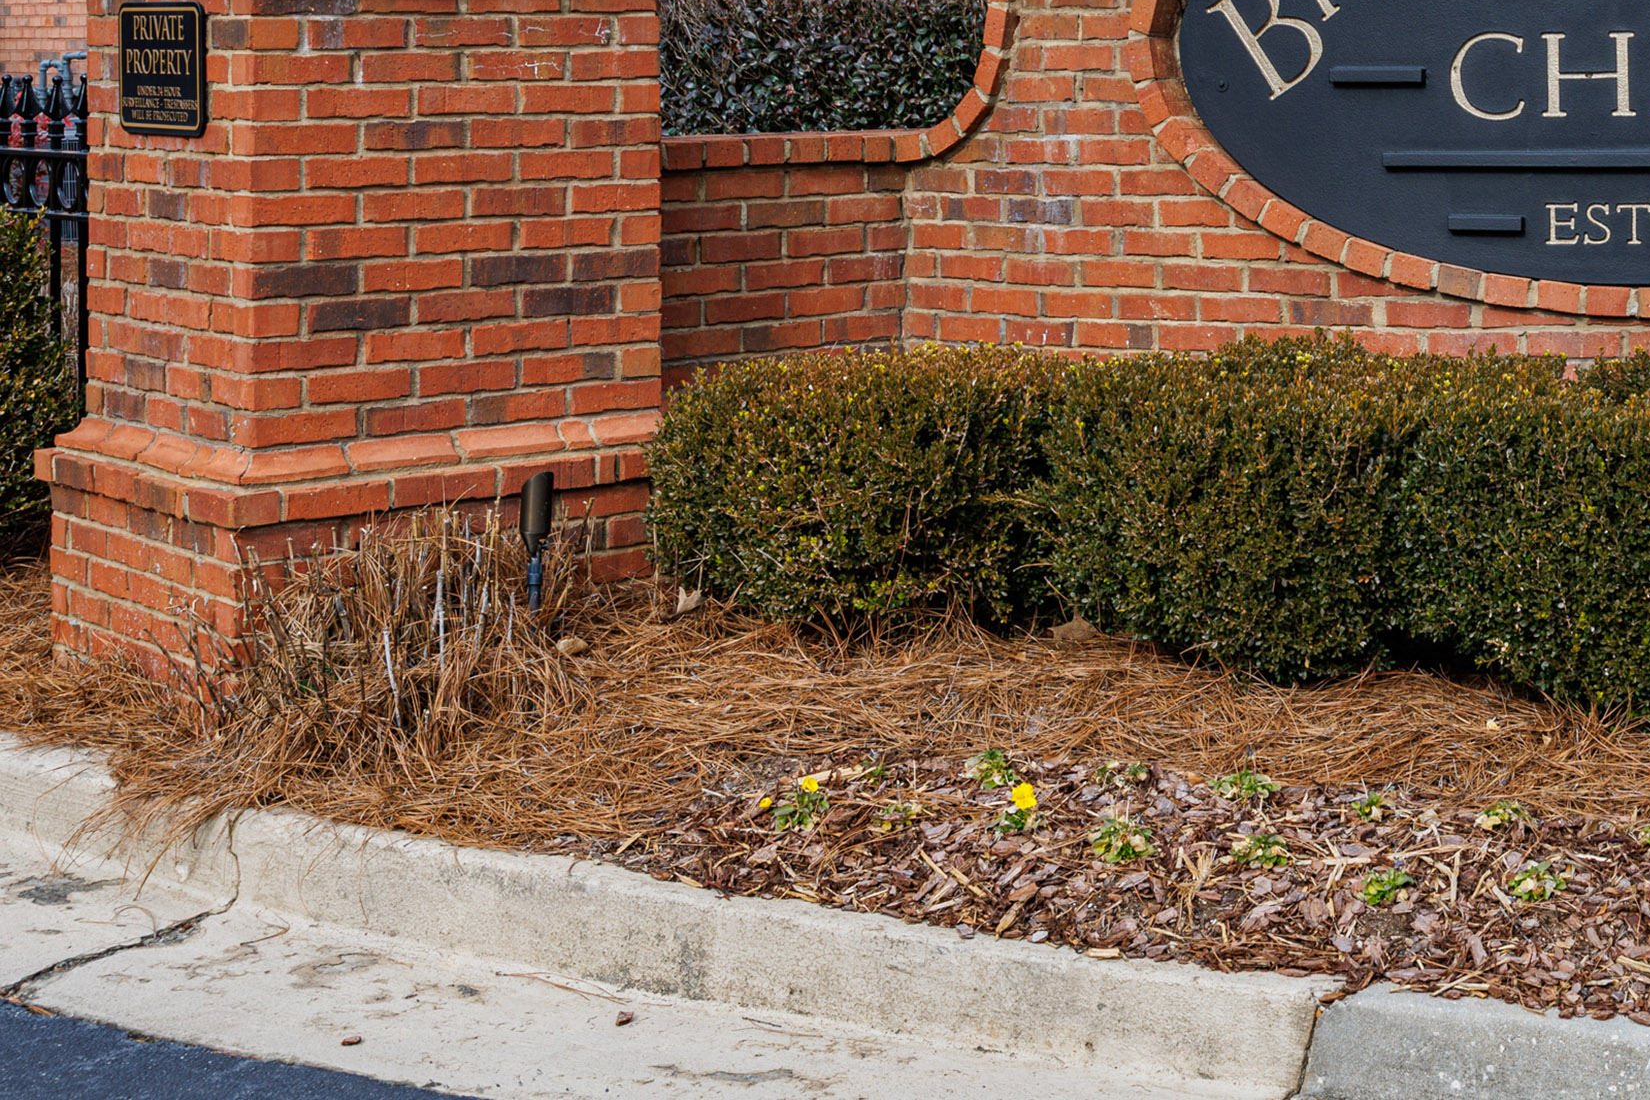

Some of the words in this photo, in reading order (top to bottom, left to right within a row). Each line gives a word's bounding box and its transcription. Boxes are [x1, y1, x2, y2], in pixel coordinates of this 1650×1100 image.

[133, 15, 184, 41] PRIVATE
[126, 48, 192, 75] PROPERTY
[137, 85, 156, 96] UNDER
[163, 86, 182, 97] HOUR
[132, 109, 145, 120] WILL
